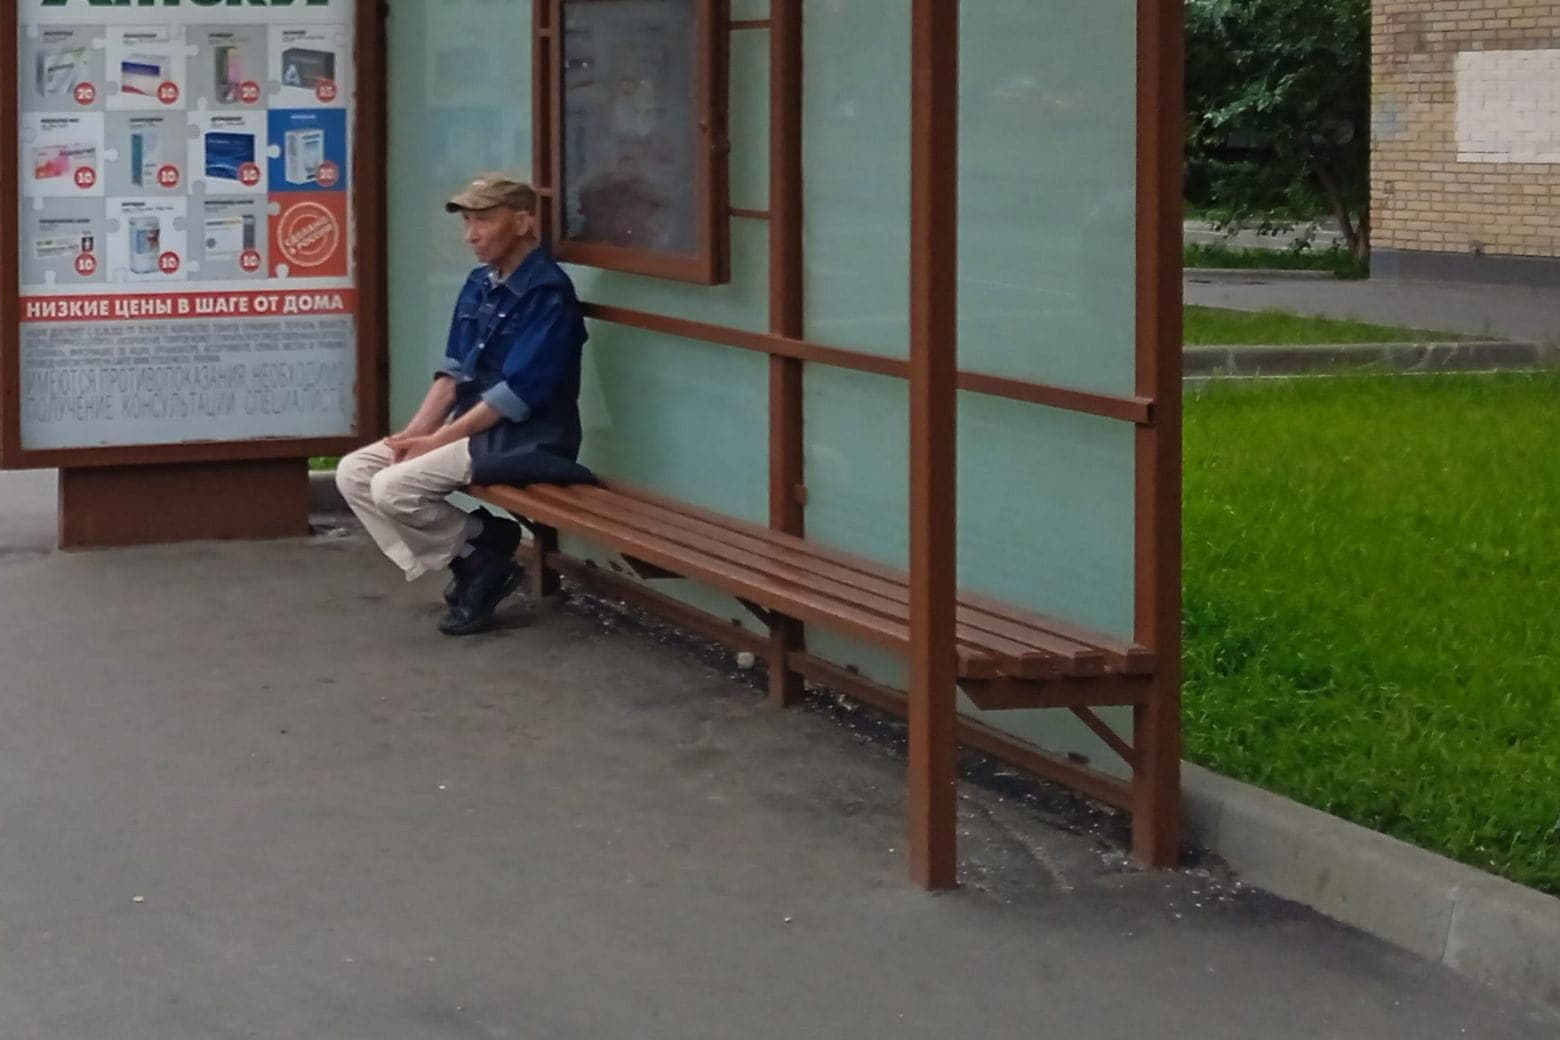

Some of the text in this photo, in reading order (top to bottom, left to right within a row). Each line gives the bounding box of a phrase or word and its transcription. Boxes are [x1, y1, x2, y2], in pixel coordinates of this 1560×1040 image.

[26, 294, 344, 318] НИЗКИЕ ЦЕНЫ В ШАГЕ ОТ ДОМА
